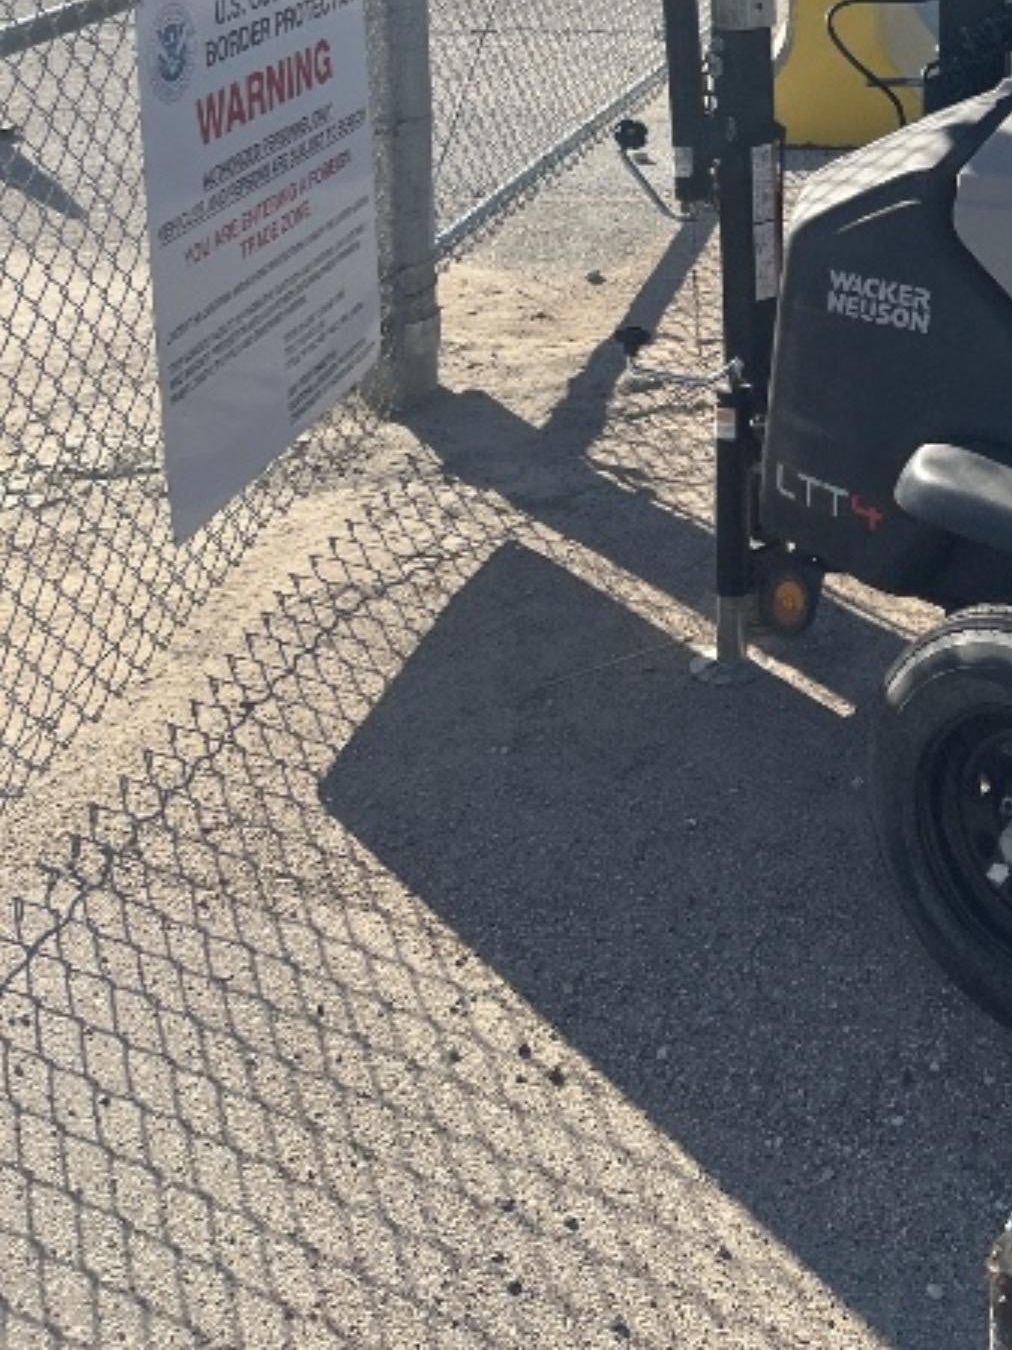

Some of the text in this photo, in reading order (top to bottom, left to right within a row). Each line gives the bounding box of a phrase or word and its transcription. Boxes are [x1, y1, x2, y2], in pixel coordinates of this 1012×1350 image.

[205, 15, 271, 67] BORDER
[196, 39, 332, 143] WARNING
[829, 268, 932, 308] WACKER
[827, 291, 932, 334] NEUSON
